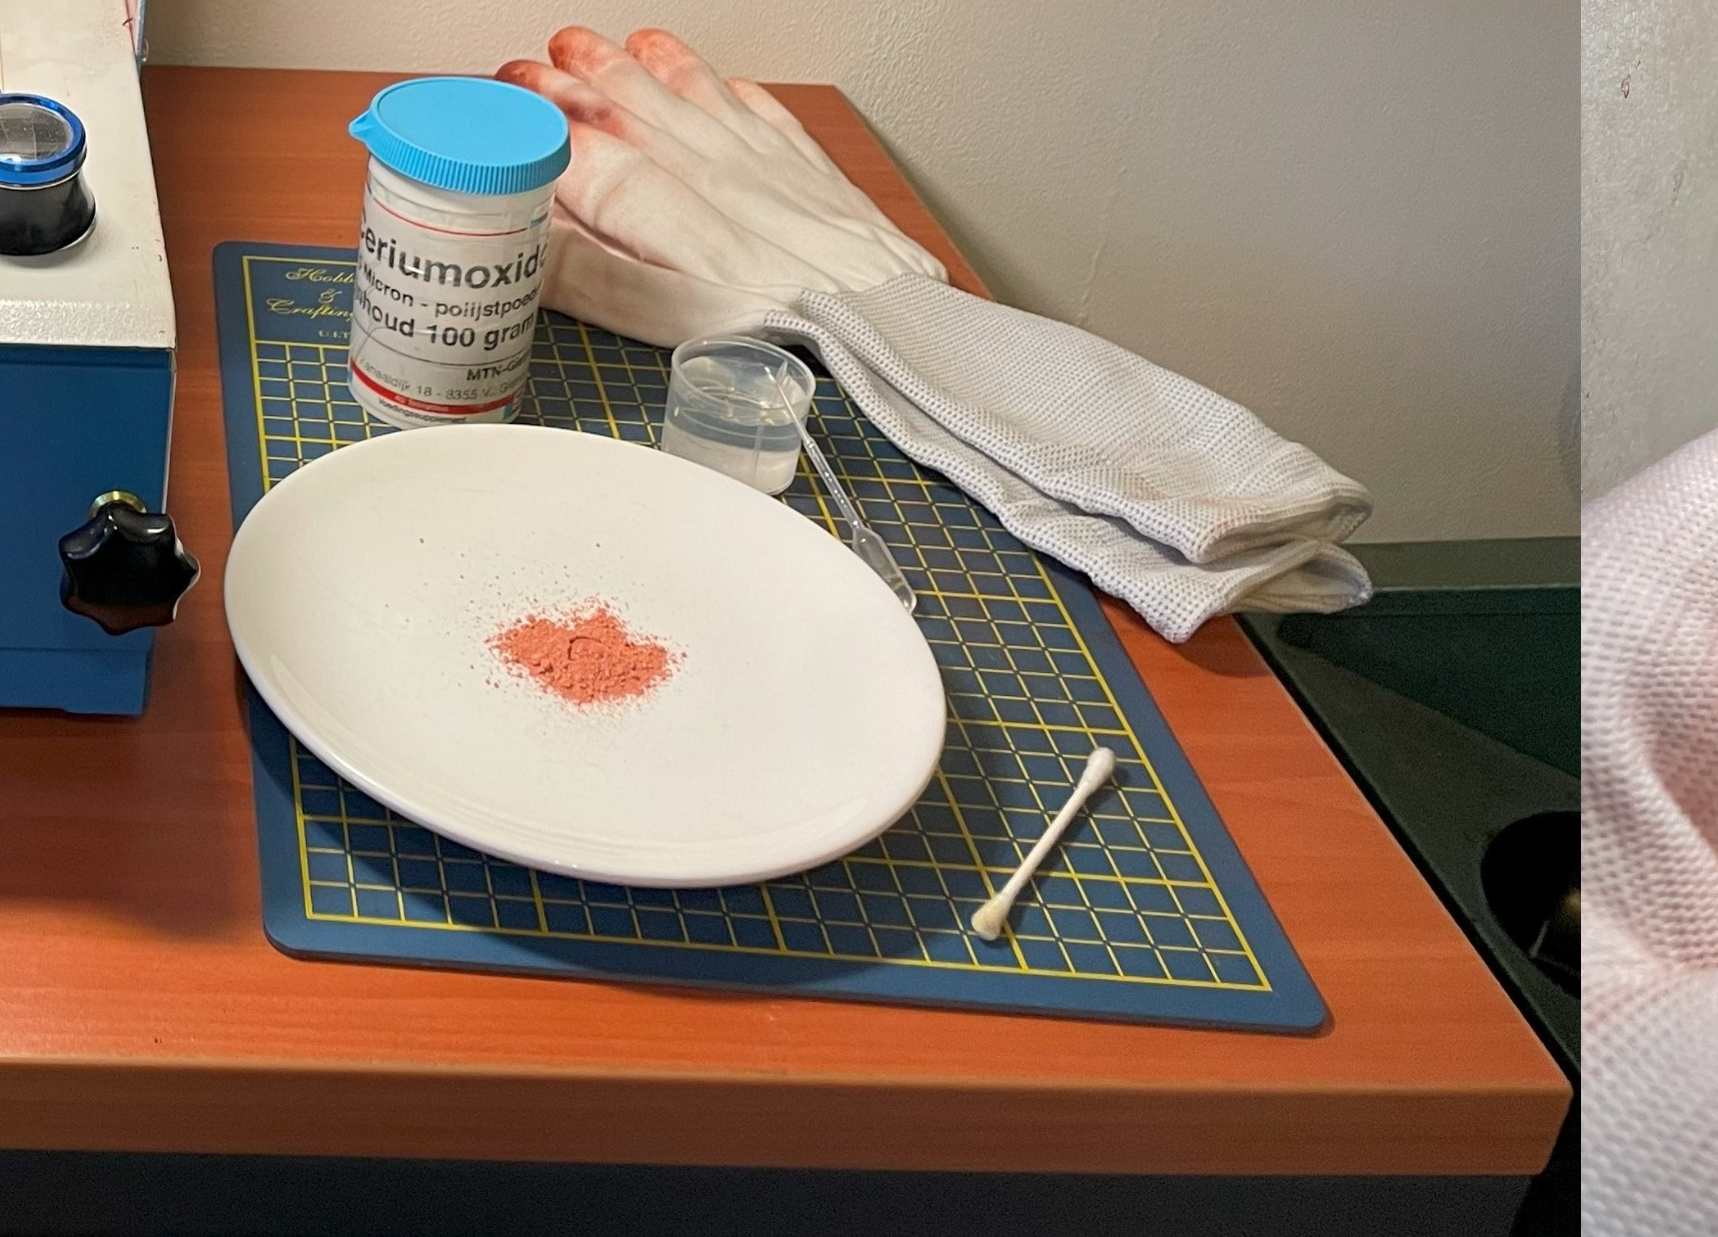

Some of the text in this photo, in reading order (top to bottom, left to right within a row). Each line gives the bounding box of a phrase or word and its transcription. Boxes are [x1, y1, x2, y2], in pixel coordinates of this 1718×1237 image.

[360, 206, 547, 290] eriumoxid
[284, 267, 354, 283] Hobb
[363, 264, 414, 308] Micron
[426, 324, 475, 348] 100
[483, 312, 533, 351] gram
[417, 385, 432, 397] 18
